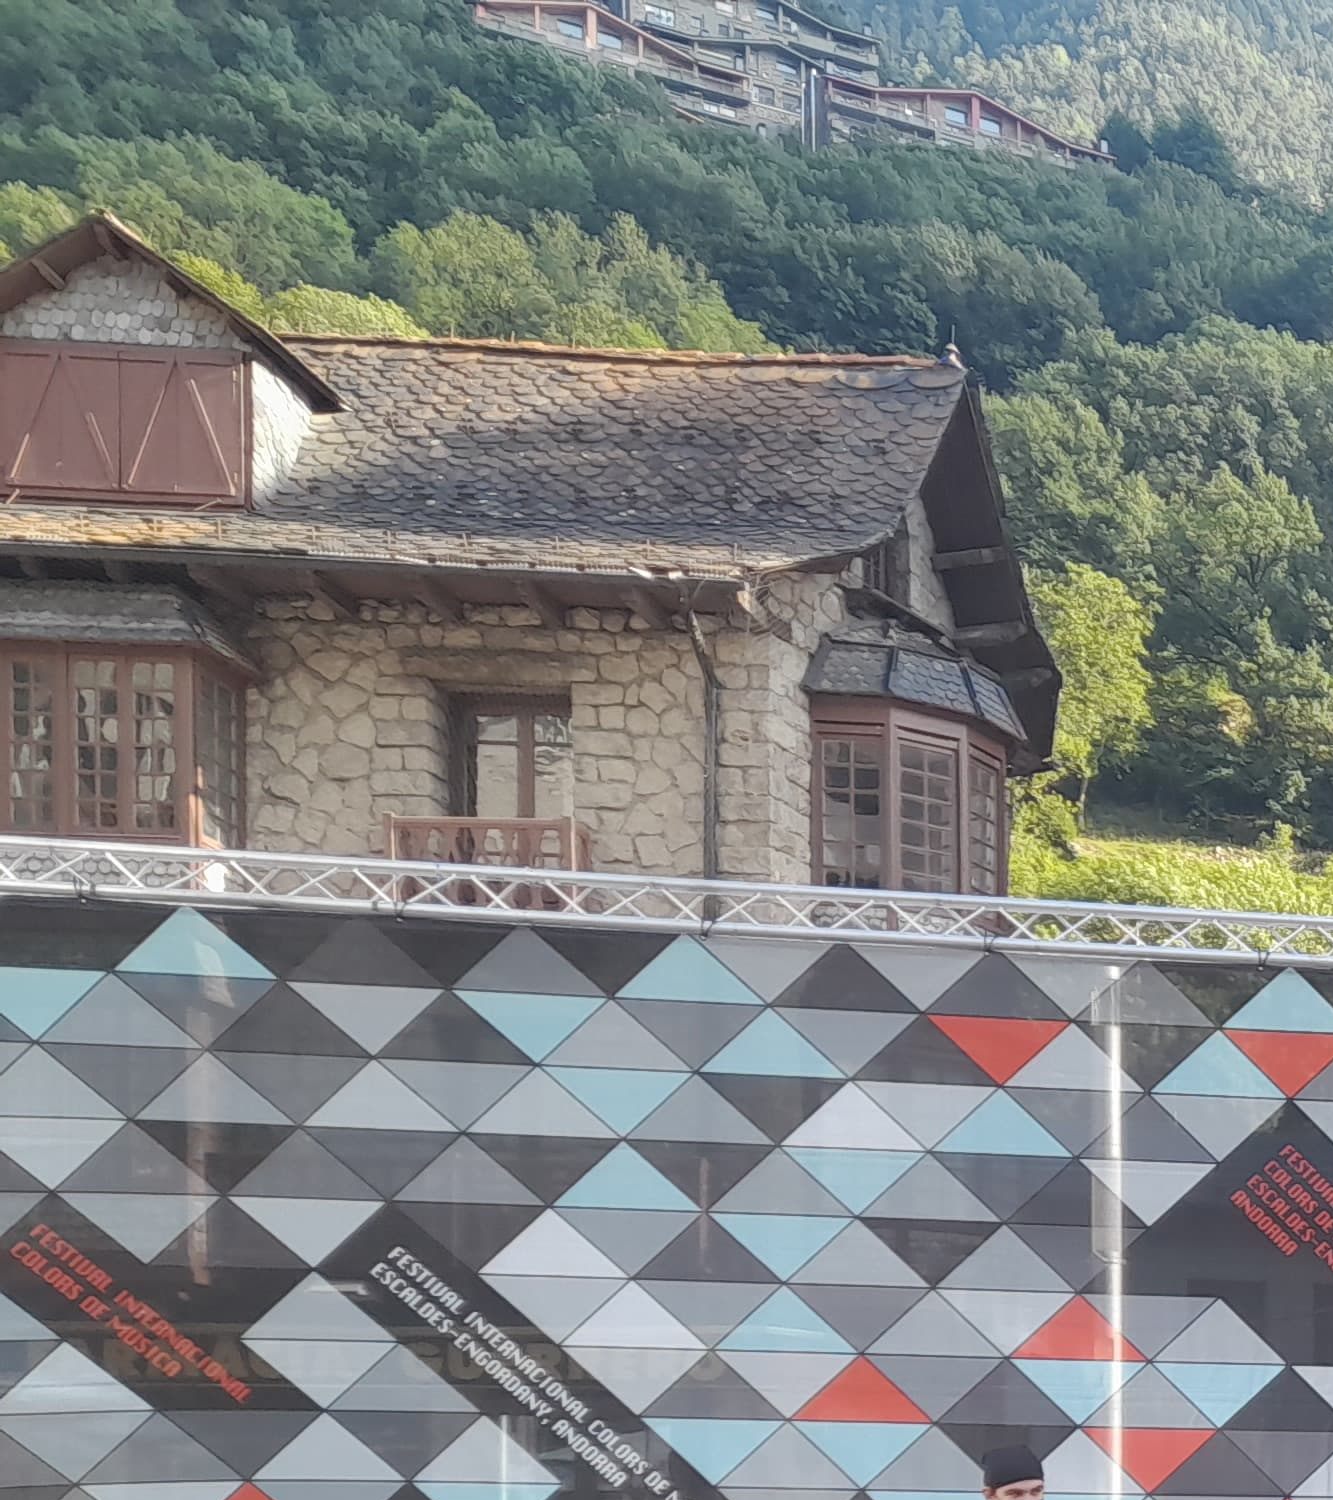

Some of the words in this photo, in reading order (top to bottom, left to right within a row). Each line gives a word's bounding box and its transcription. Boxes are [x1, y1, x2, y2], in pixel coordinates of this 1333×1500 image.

[1229, 1189, 1300, 1257] ANDORRA
[1263, 1159, 1319, 1216] COLORS
[10, 1241, 84, 1300] COLORS
[79, 1295, 111, 1320] DE
[29, 1223, 115, 1292] FESTIVAL
[113, 1289, 253, 1404] INTERNACIONAL
[387, 1246, 466, 1316] FESTIVAL
[463, 1311, 590, 1424] INTERNACIONAL
[587, 1418, 650, 1476] COLORS
[643, 1469, 671, 1496] DE
[551, 1418, 628, 1487] ANDORRA
